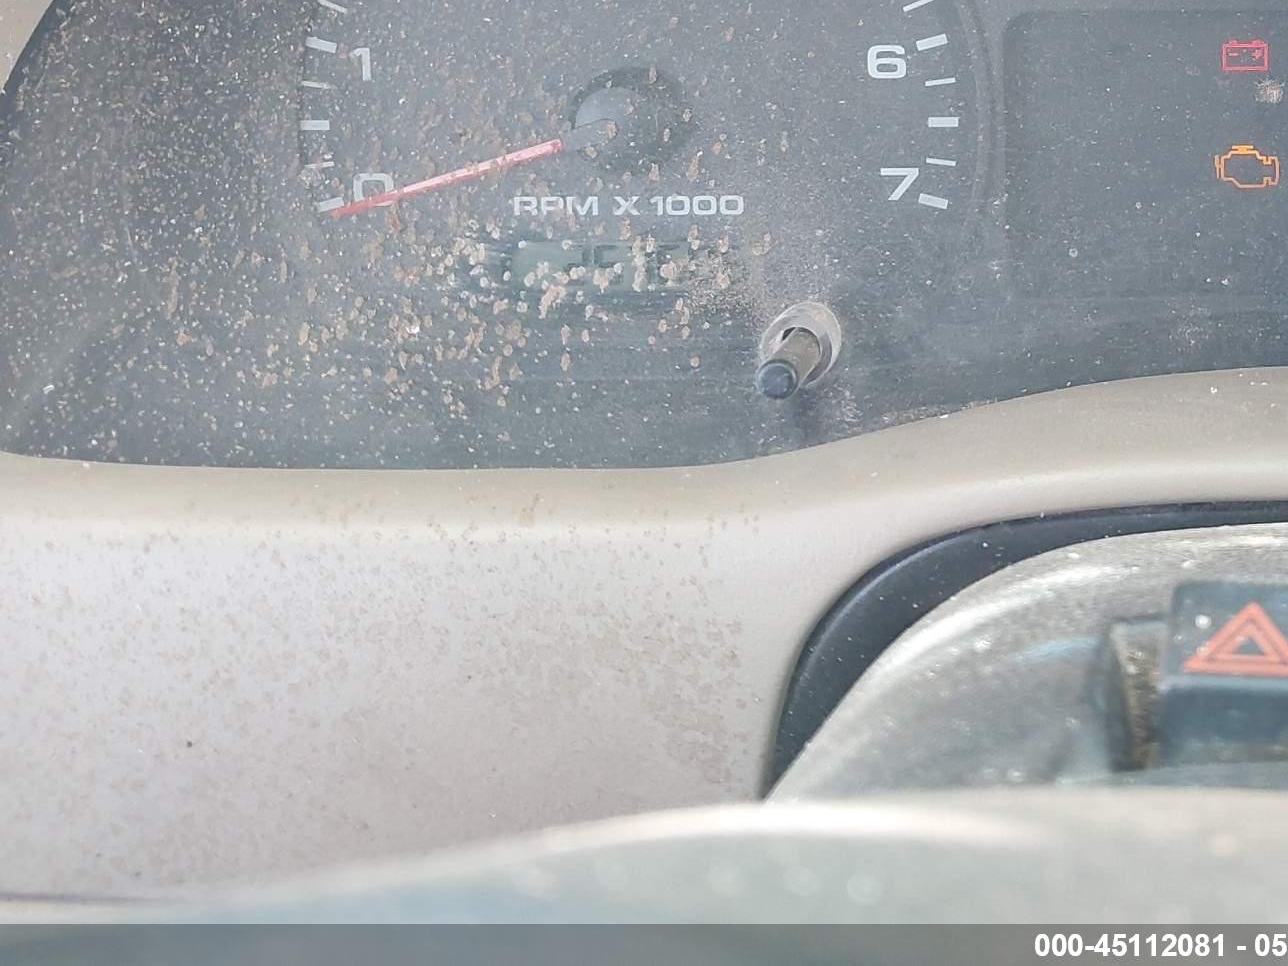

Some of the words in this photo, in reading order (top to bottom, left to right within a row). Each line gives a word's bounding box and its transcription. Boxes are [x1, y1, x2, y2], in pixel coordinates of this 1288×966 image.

[347, 46, 372, 81] 1
[867, 45, 906, 79] 6
[352, 173, 395, 207] 0
[879, 167, 920, 200] 7
[513, 195, 599, 216] RPM
[613, 195, 641, 216] X
[650, 194, 744, 216] 1000
